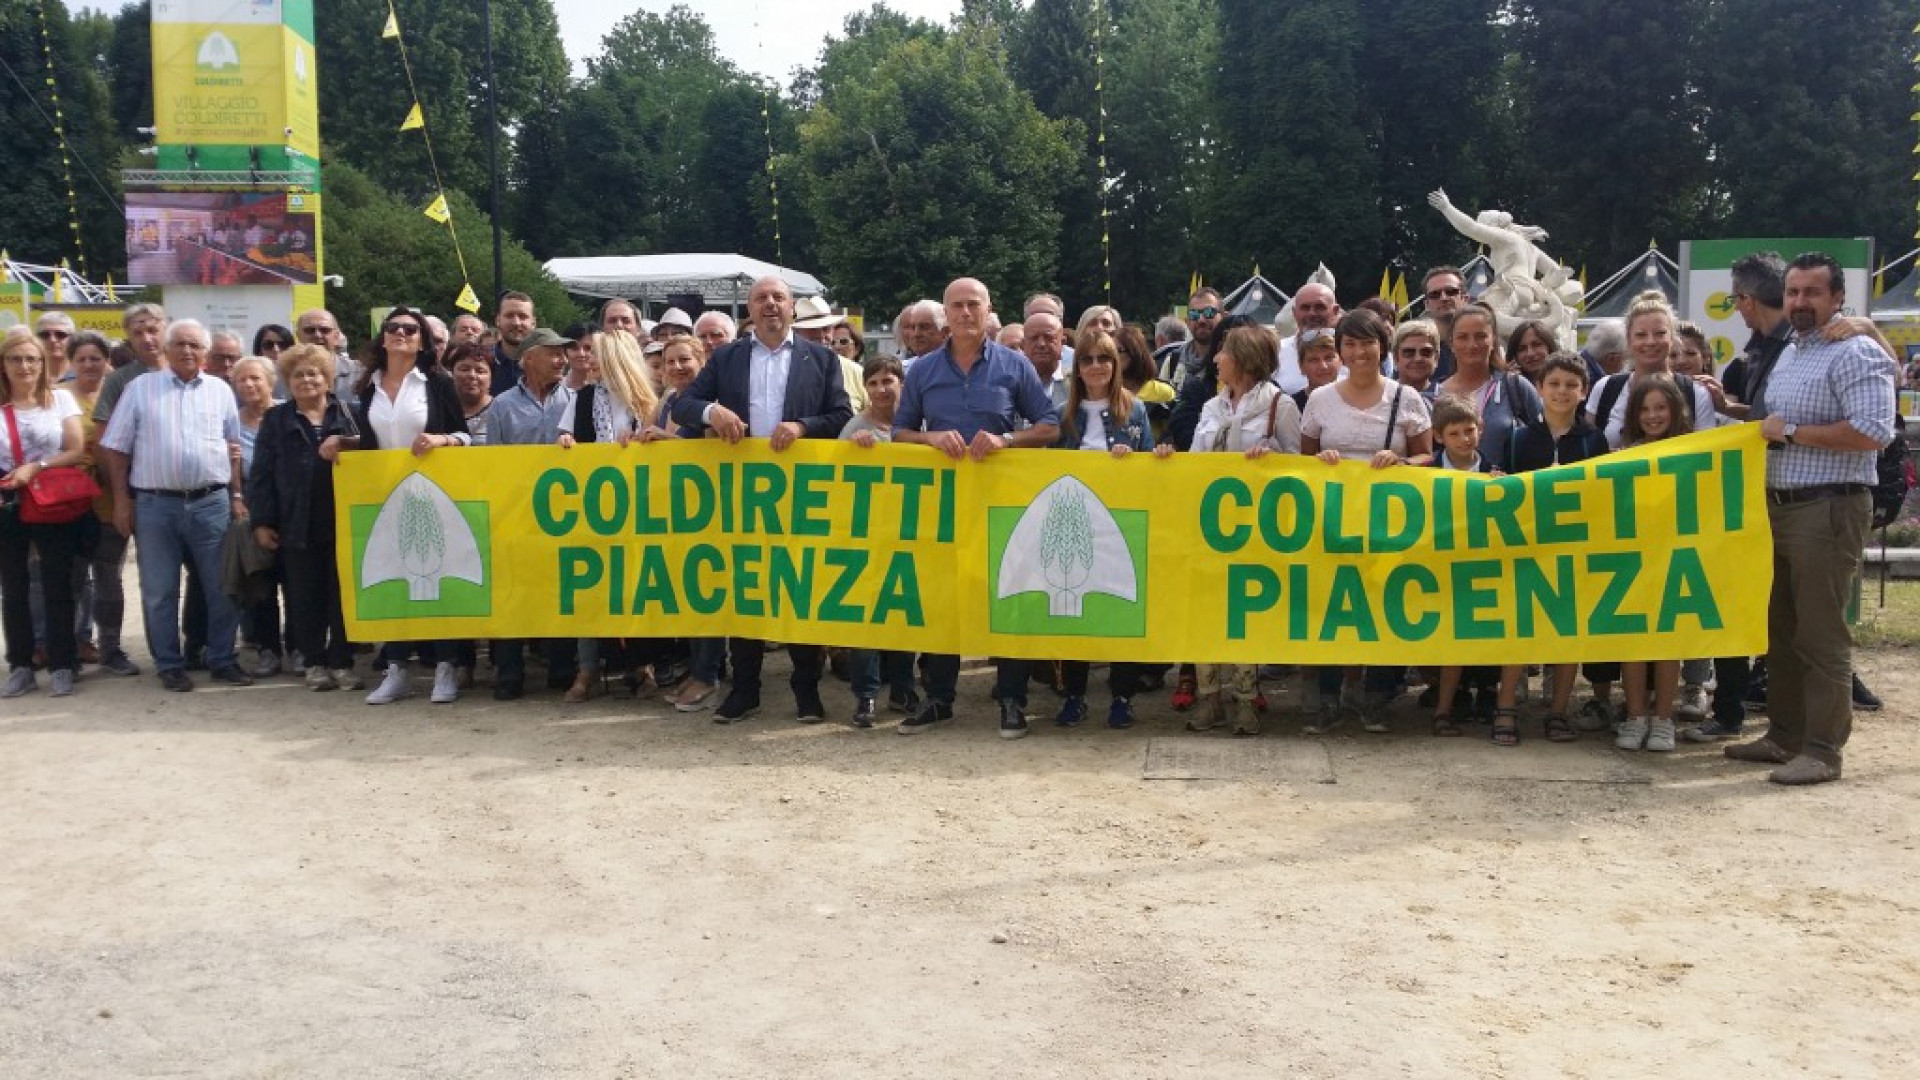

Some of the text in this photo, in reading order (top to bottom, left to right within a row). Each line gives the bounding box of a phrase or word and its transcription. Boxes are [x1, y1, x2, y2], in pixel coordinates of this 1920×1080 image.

[174, 96, 258, 110] VILLAGGIO
[174, 112, 267, 125] COLDIRETTI
[533, 464, 954, 543] COLDIRETTI
[1200, 451, 1743, 552] COLDIRETTI
[559, 545, 923, 626] PIACENZA
[1228, 549, 1722, 640] PIACENZA
